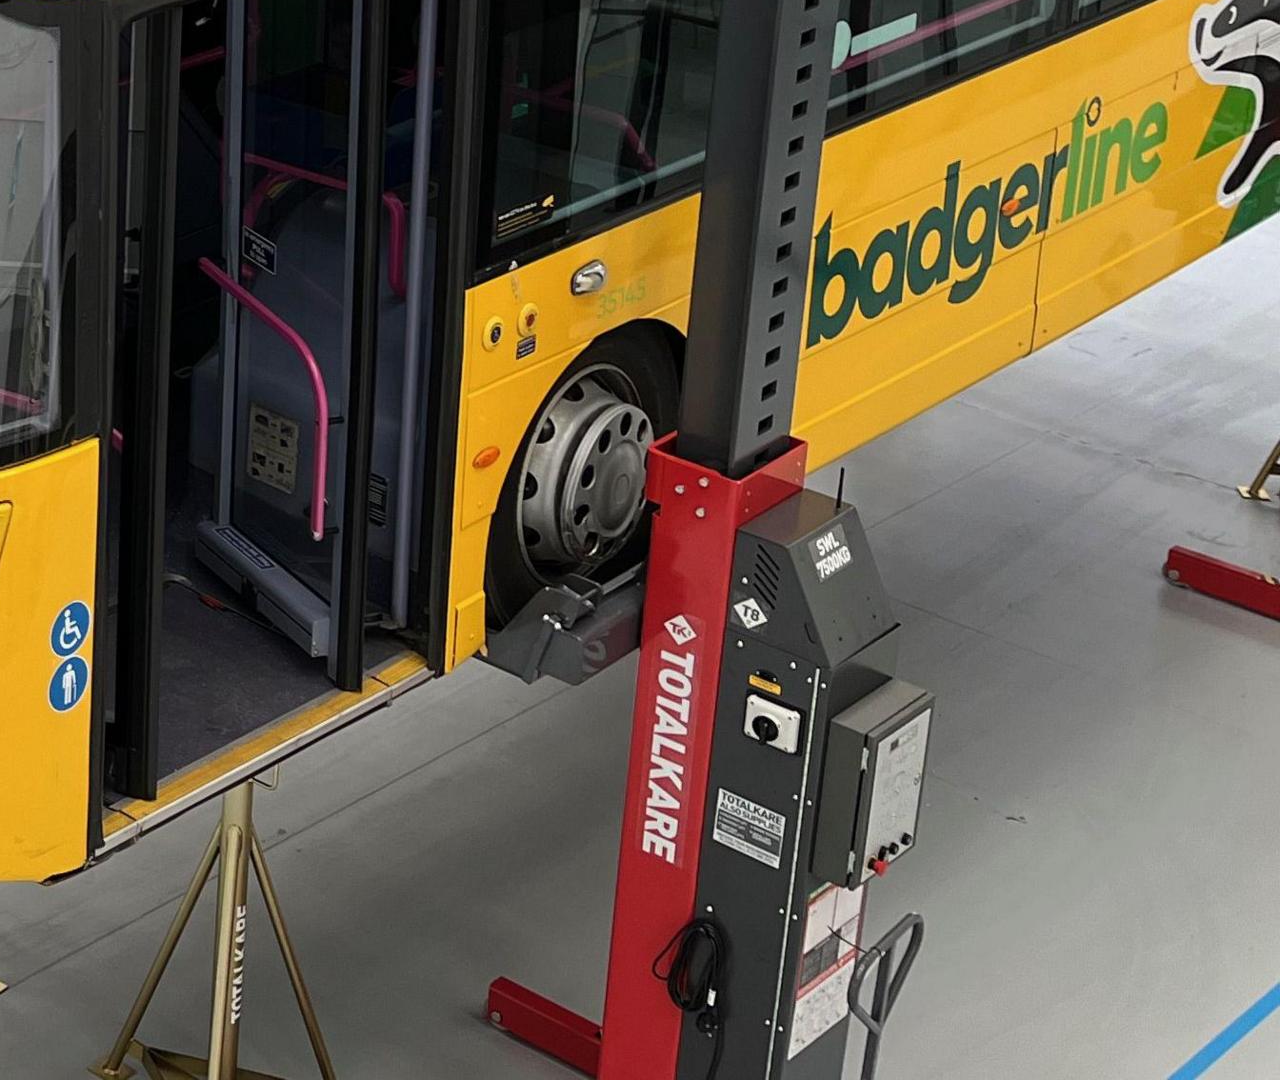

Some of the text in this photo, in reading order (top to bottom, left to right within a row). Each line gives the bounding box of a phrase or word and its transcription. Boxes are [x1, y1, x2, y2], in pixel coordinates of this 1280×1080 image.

[806, 97, 1169, 349] badgerline
[816, 531, 840, 556] SWL
[815, 545, 852, 579] 7500KG
[742, 603, 760, 622] T8
[642, 649, 695, 864] TOTALKARE
[720, 801, 742, 815] ALSO
[722, 791, 783, 825] TOTALKARE
